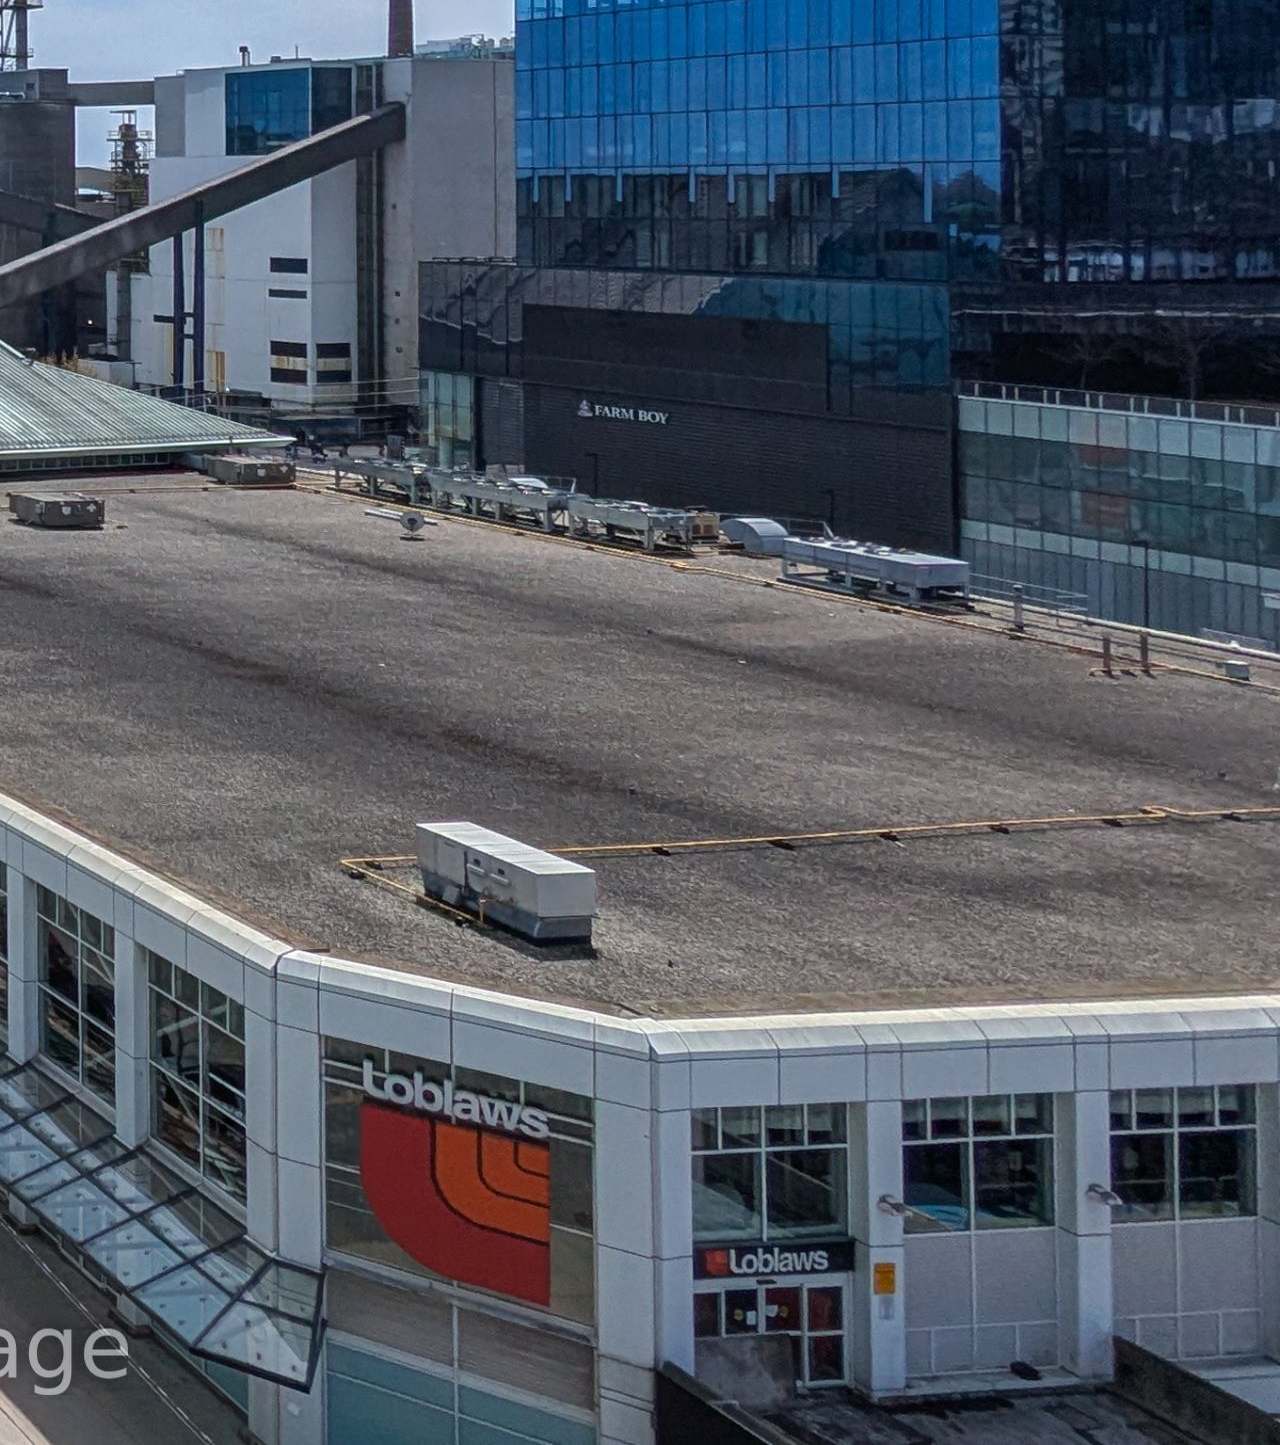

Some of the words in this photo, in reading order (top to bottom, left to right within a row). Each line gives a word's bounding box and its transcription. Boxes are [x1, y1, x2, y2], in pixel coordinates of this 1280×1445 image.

[594, 404, 635, 420] FARM
[638, 409, 669, 424] BOY
[362, 1059, 551, 1139] Loblaws
[729, 1247, 829, 1274] Loblaws
